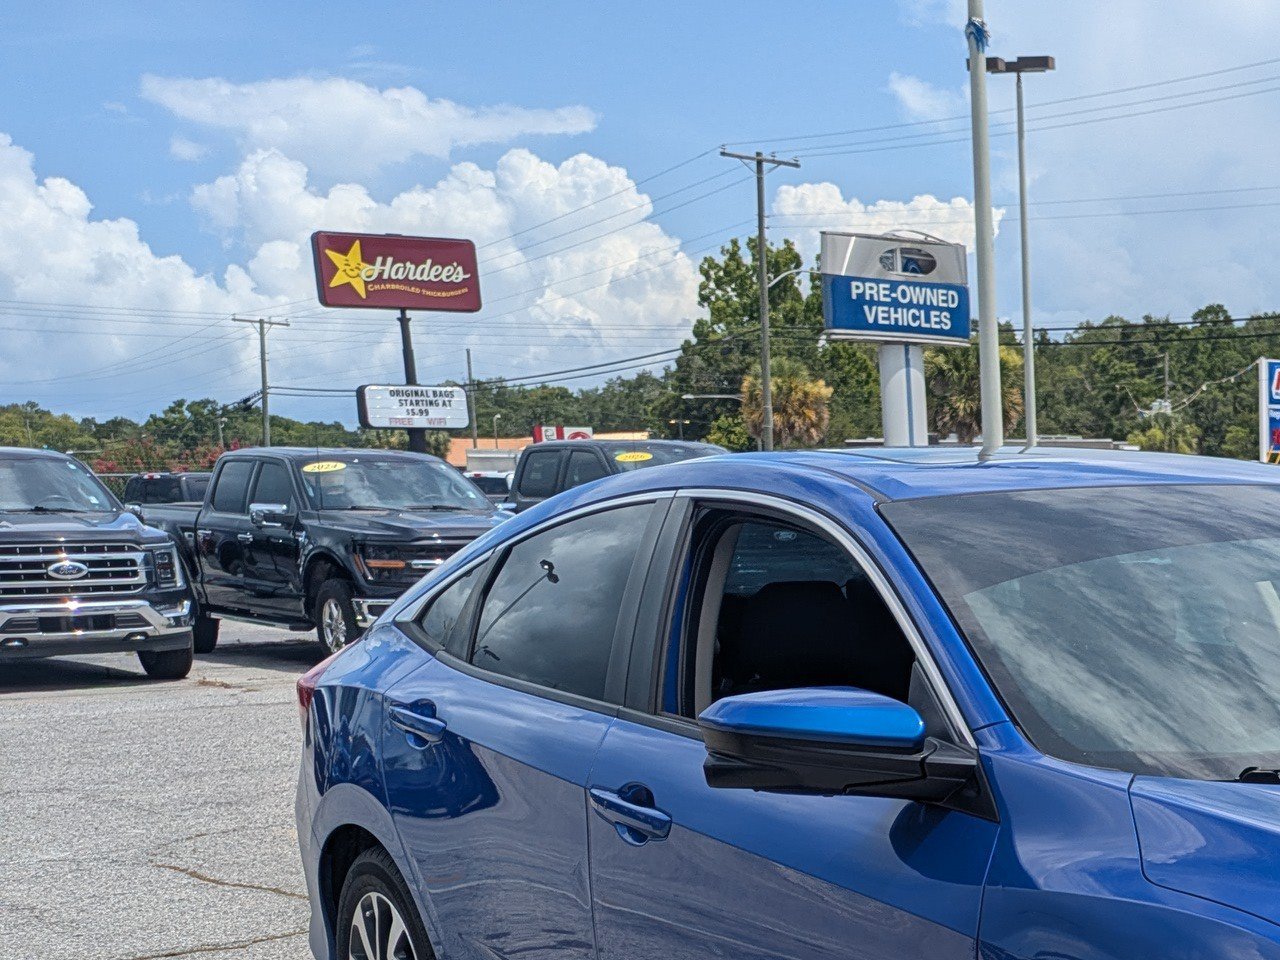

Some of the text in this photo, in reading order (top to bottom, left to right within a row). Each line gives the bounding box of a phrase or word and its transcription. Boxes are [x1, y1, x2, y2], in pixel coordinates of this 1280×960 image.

[360, 256, 471, 283] Hardee's
[850, 281, 959, 309] PRE-OWNED
[863, 305, 952, 331] VEHICLES
[389, 389, 455, 398] ORIGINAL BAGS
[398, 399, 452, 408] STARTING AT
[406, 408, 430, 417] $5.99
[389, 417, 414, 426] FREE
